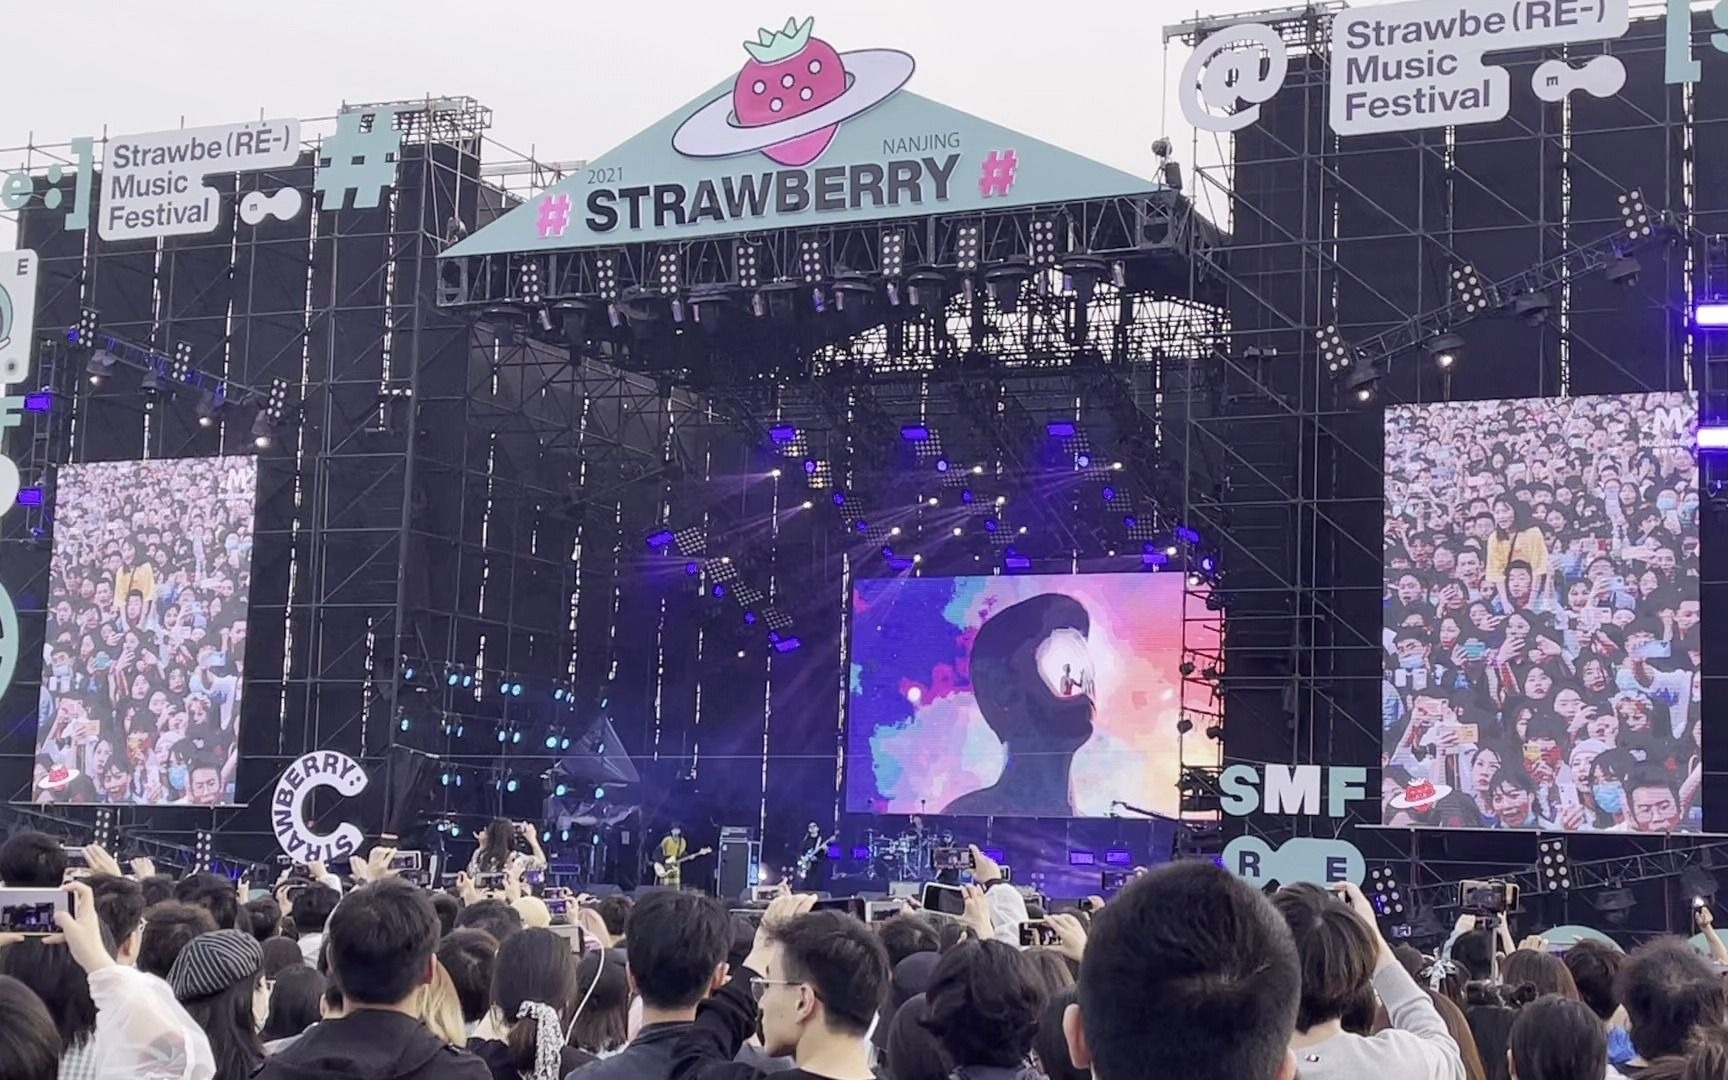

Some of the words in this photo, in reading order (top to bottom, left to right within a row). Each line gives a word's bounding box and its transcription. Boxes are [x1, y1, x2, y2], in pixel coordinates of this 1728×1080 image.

[1346, 50, 1458, 86] Music
[1345, 79, 1491, 121] Festival
[883, 132, 961, 155] NANJING
[111, 170, 188, 200] Music
[587, 167, 624, 185] 2021
[585, 153, 963, 233] STRAWBERRY
[108, 198, 210, 231] Festival
[16, 258, 29, 276] E
[1219, 764, 1367, 817] SMF
